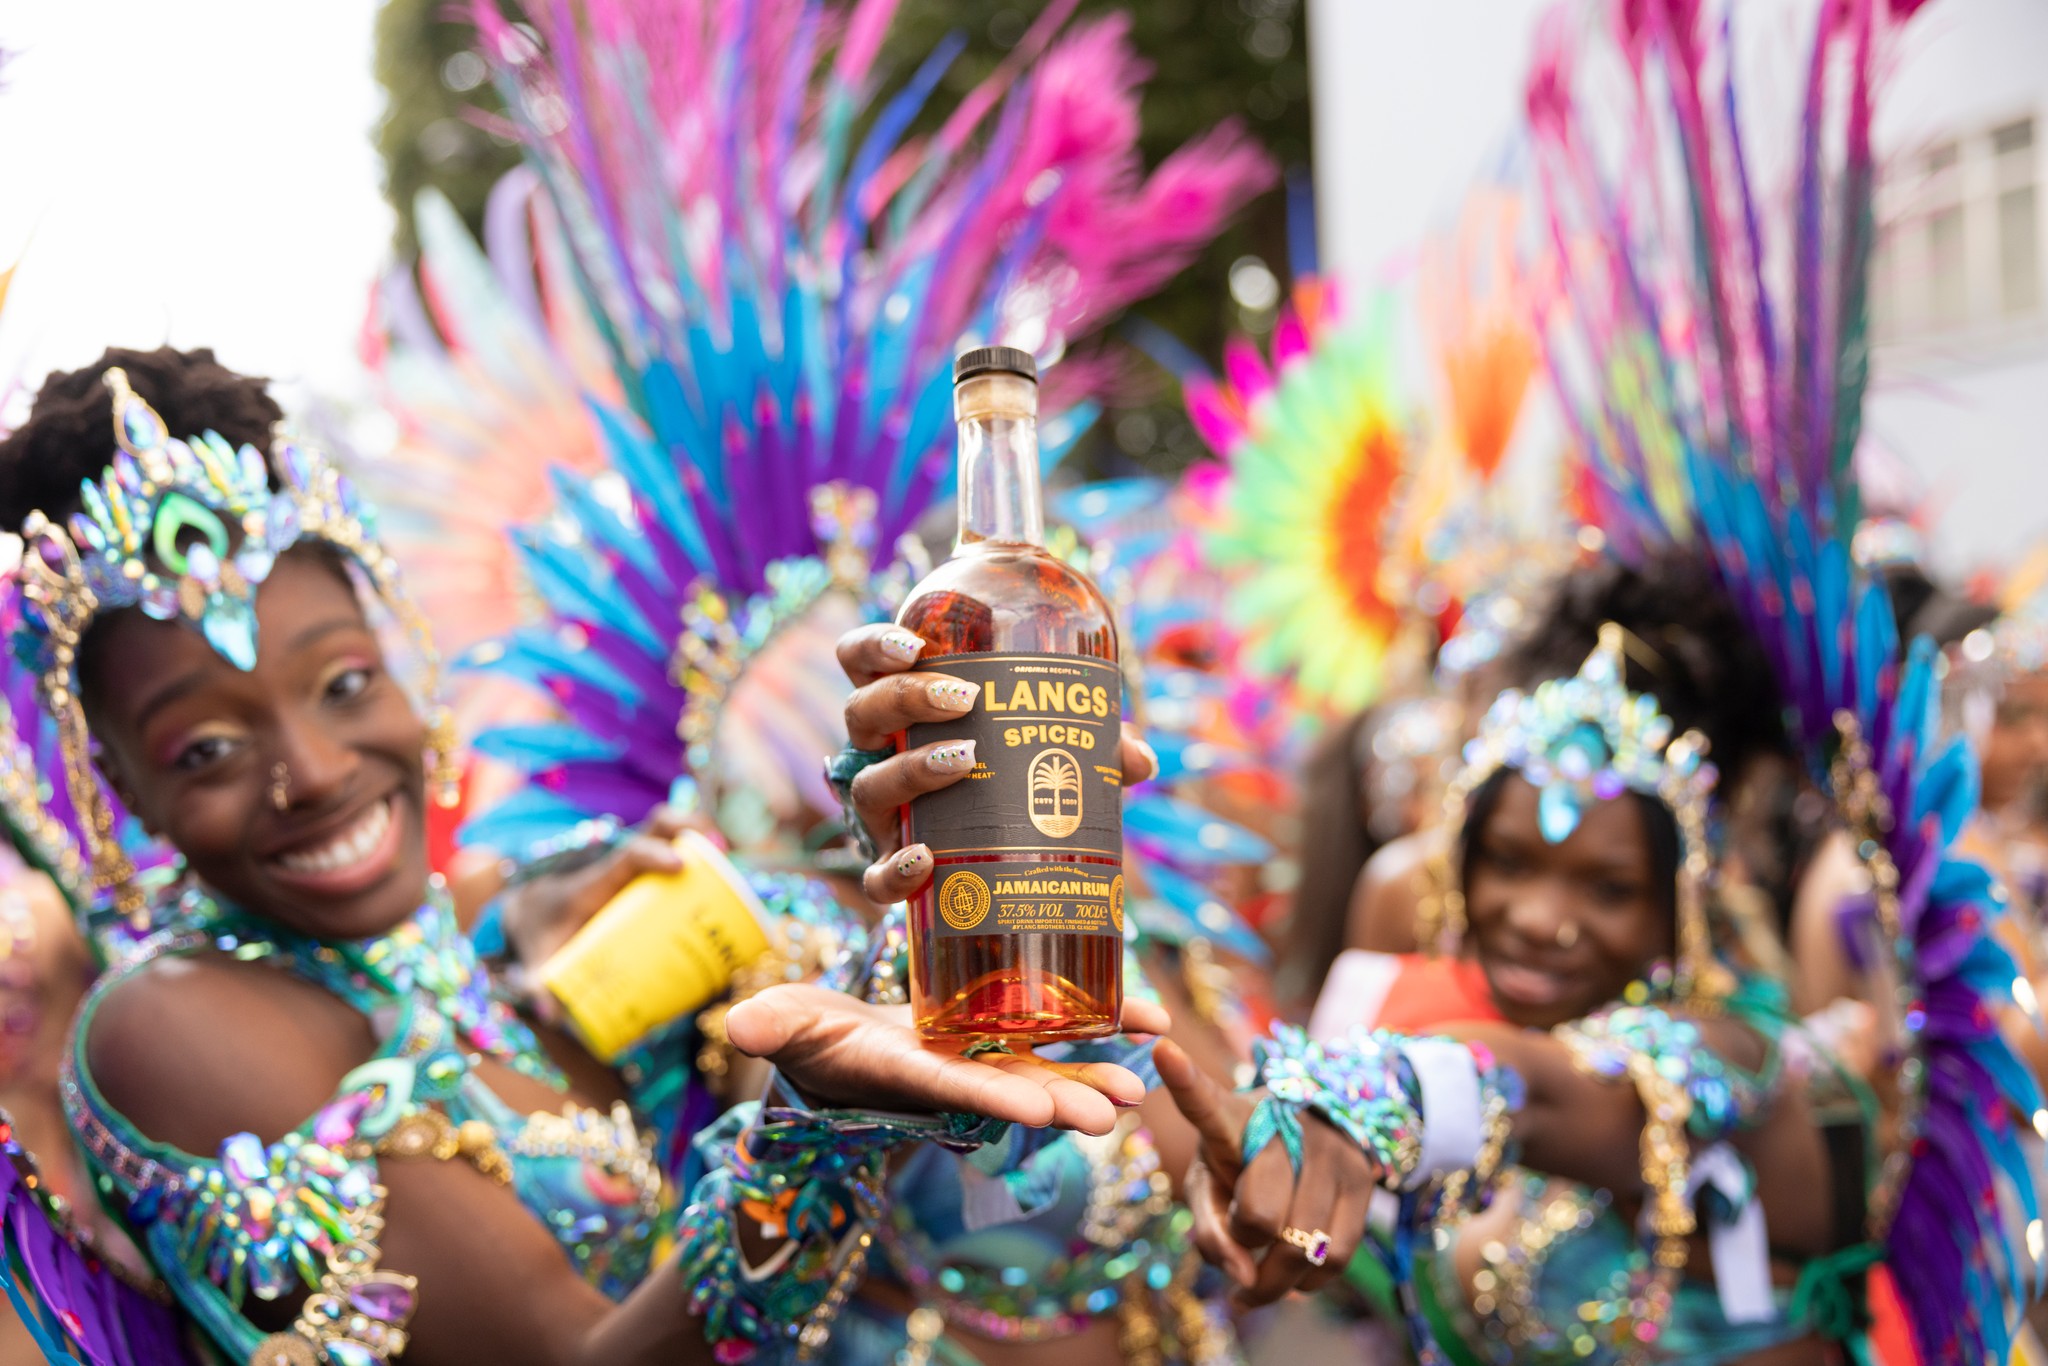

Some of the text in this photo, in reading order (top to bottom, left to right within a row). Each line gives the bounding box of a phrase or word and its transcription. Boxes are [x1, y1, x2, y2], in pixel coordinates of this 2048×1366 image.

[1014, 665, 1048, 674] ORIGINAL
[1049, 666, 1072, 675] RECIPE
[984, 680, 1108, 718] LANGS
[1003, 724, 1095, 750] SPICED
[1024, 865, 1049, 876] Crafted
[1063, 865, 1073, 873] the
[993, 880, 1110, 897] JAMAICAN RUM
[997, 903, 1036, 918] 37.5%
[1038, 903, 1064, 918] VOL
